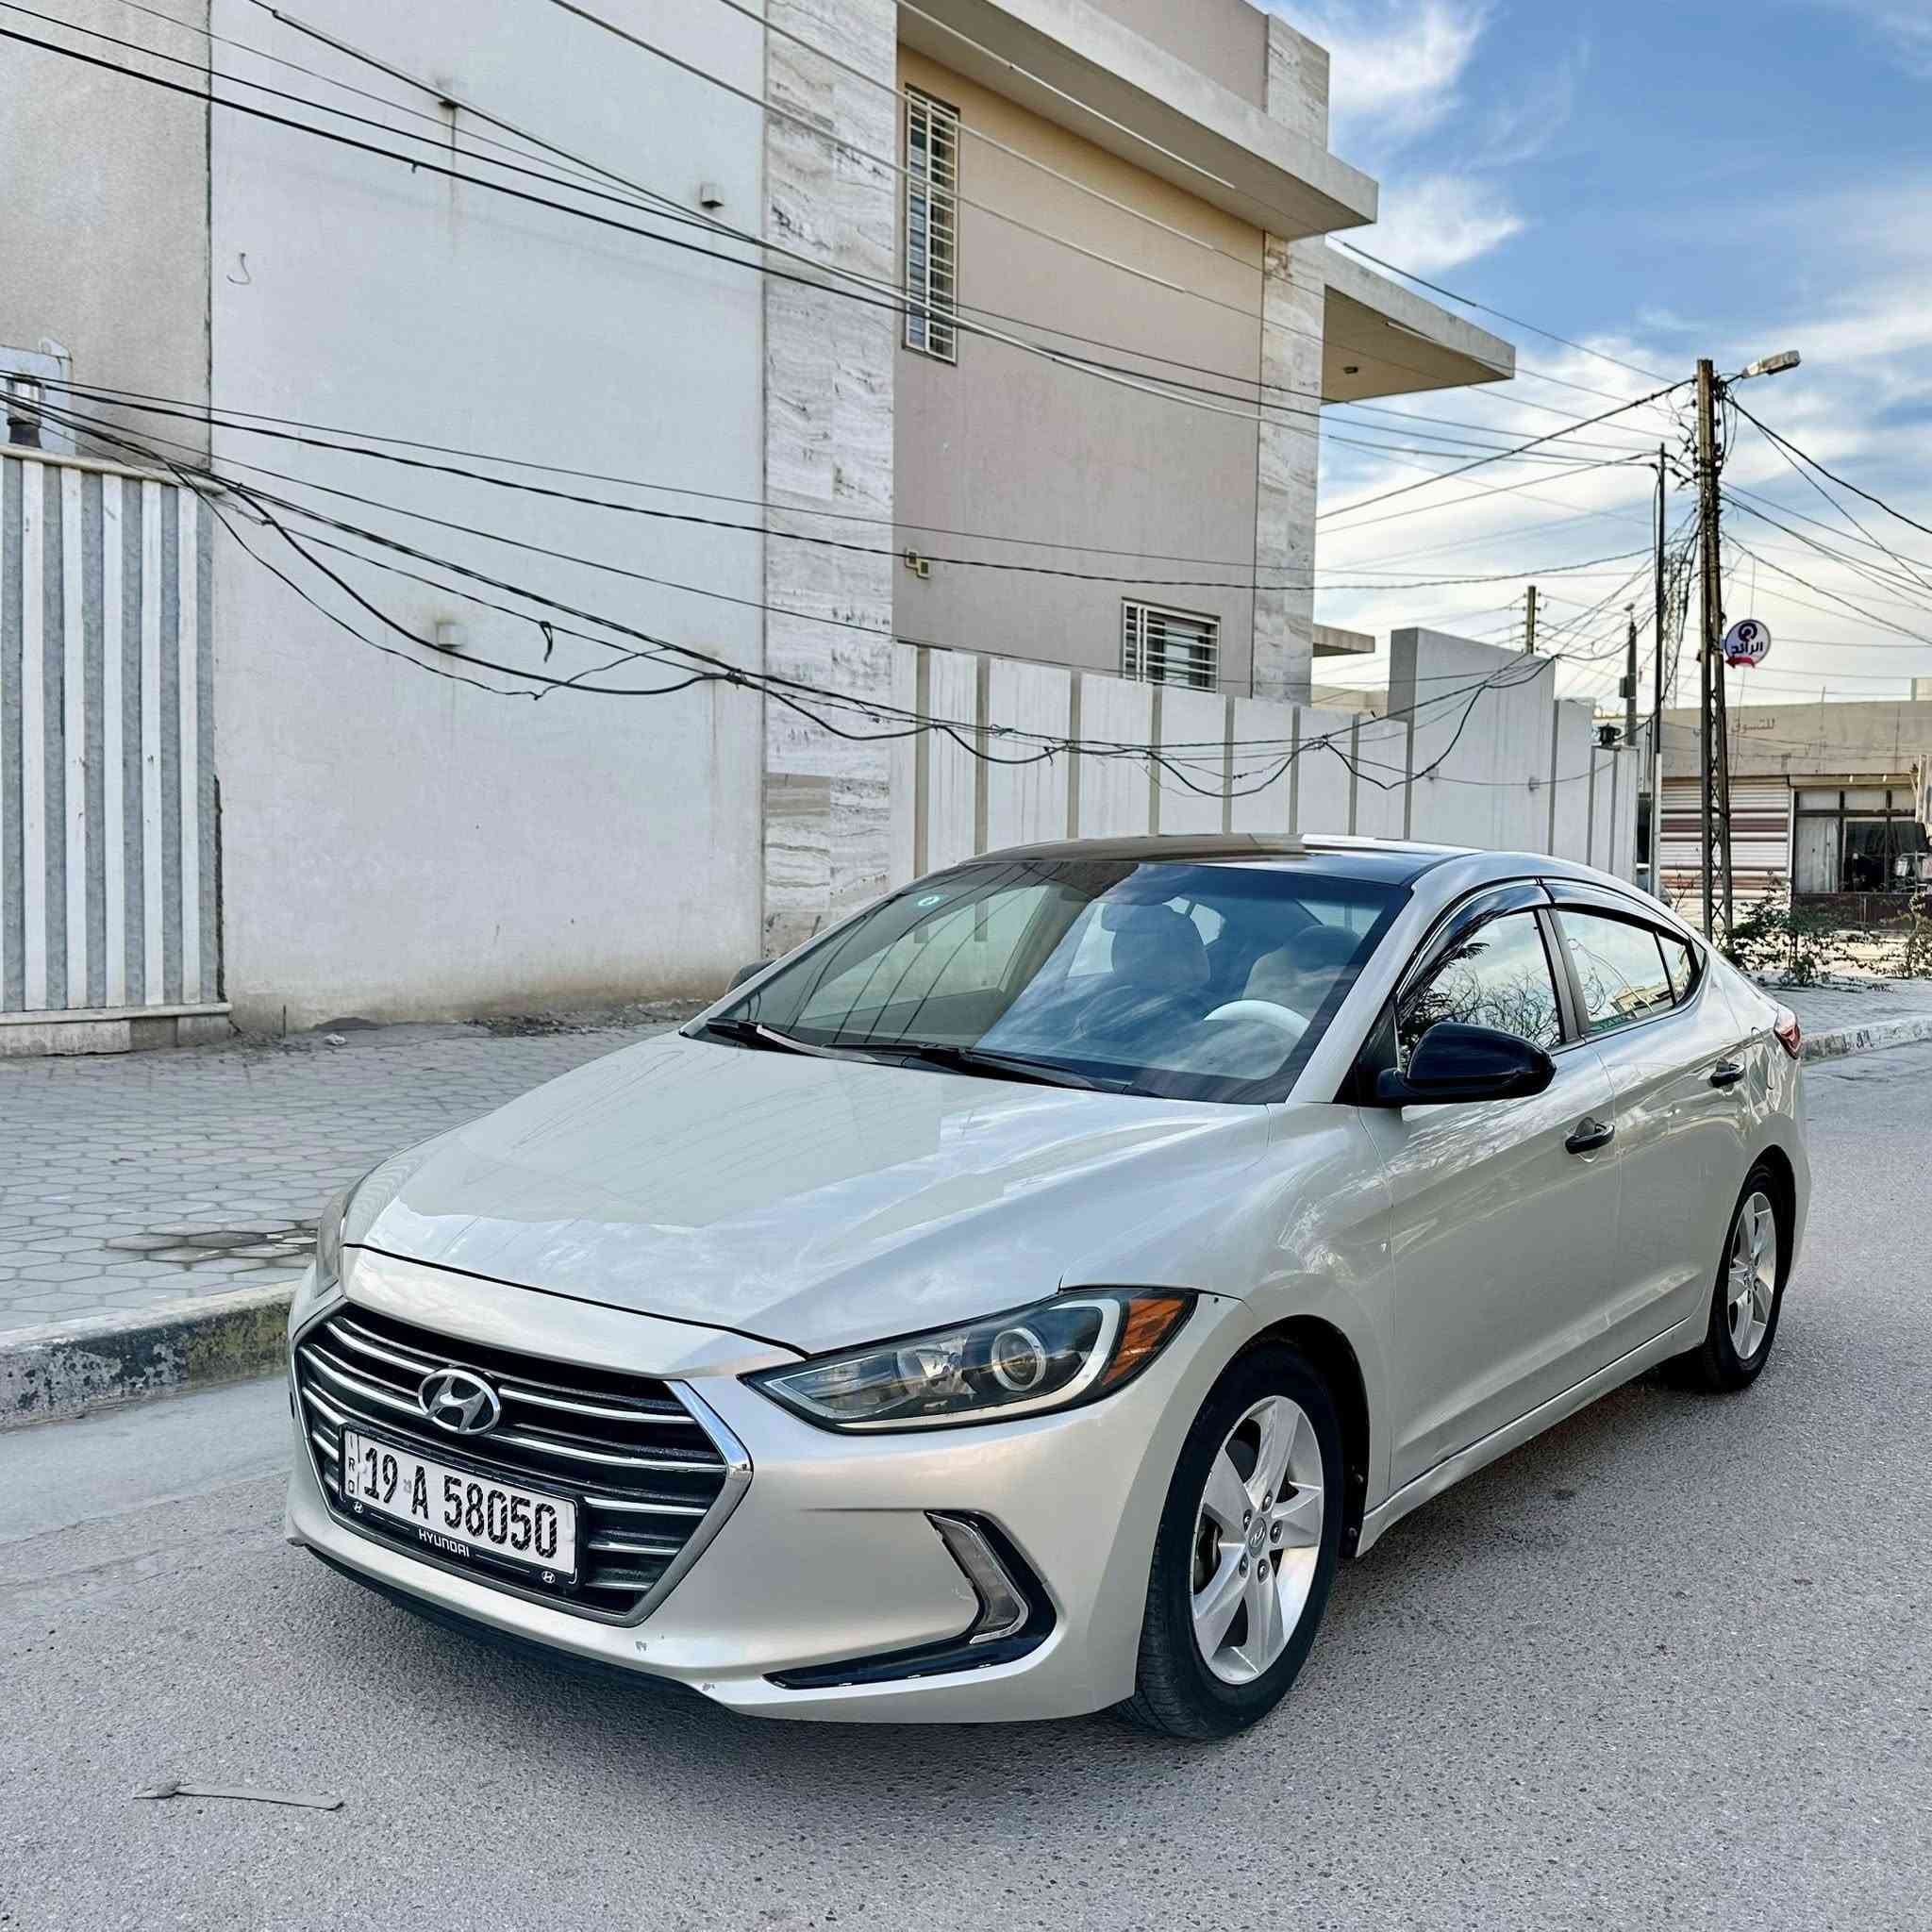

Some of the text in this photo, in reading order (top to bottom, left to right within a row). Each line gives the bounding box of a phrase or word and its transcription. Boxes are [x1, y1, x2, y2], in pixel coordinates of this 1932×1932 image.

[364, 1447, 558, 1558] 19 A 58050
[419, 1528, 470, 1557] HYUNDAI
